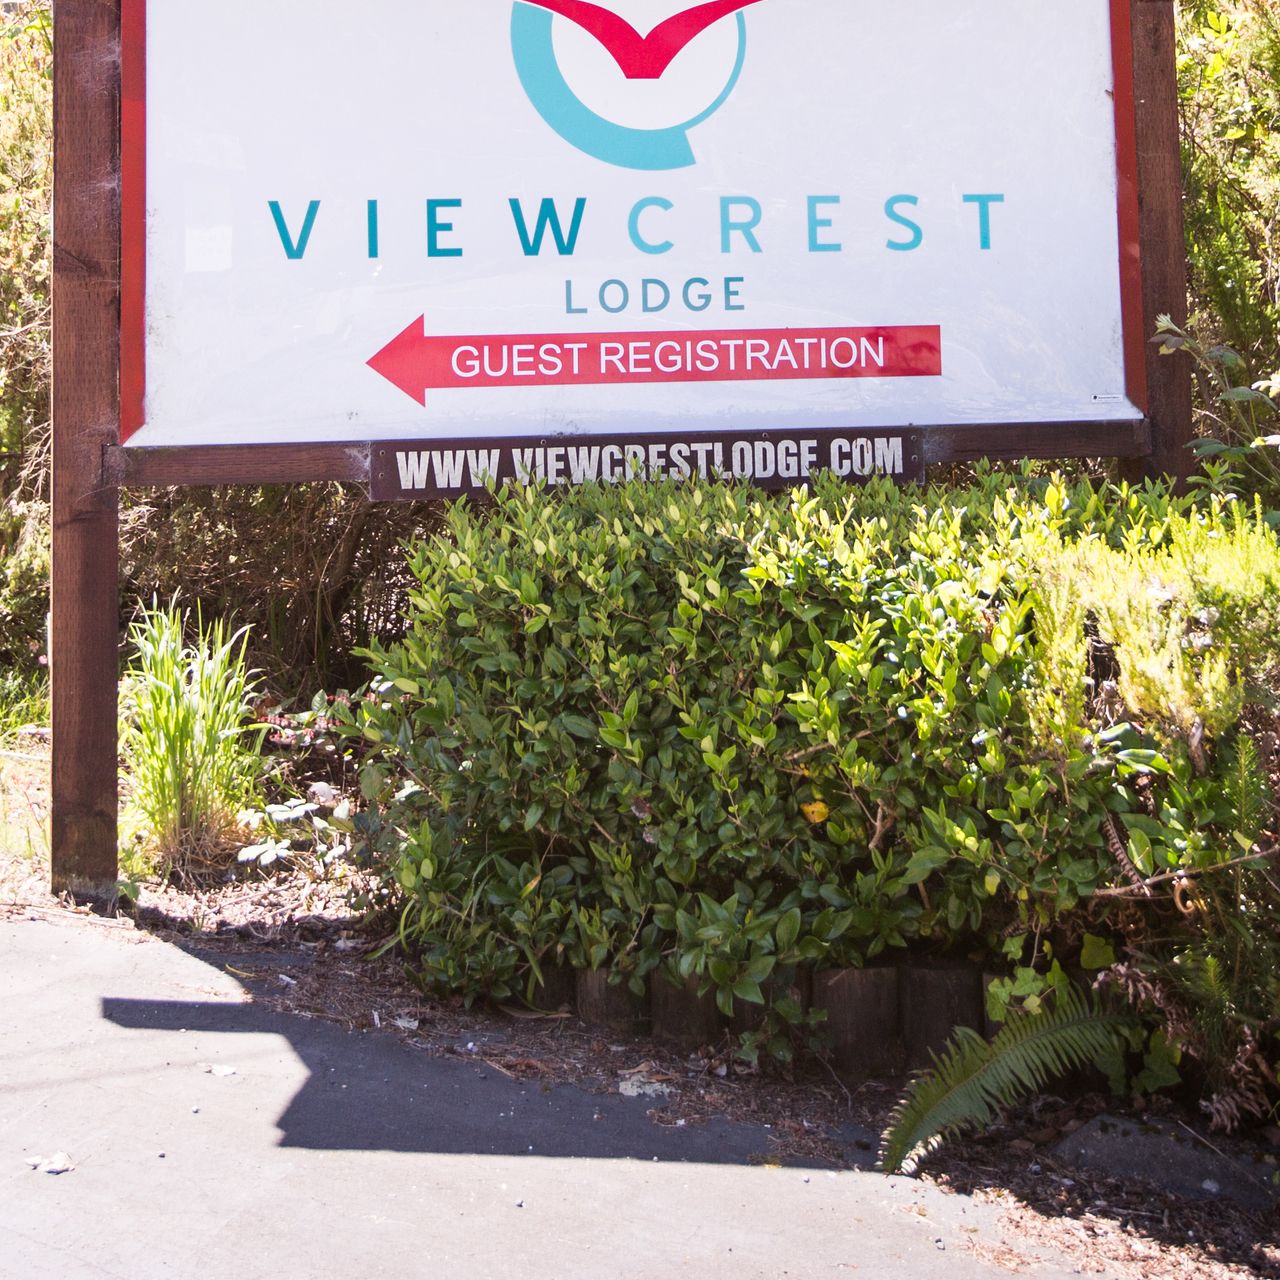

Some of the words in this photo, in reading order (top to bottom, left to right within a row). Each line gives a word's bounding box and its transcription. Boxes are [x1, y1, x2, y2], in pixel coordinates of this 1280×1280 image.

[565, 276, 746, 314] LODGE
[450, 342, 588, 379] GUEST
[599, 336, 886, 374] REGISTRATION
[395, 436, 904, 490] WWW.VIEWCRESTLODGECOM
